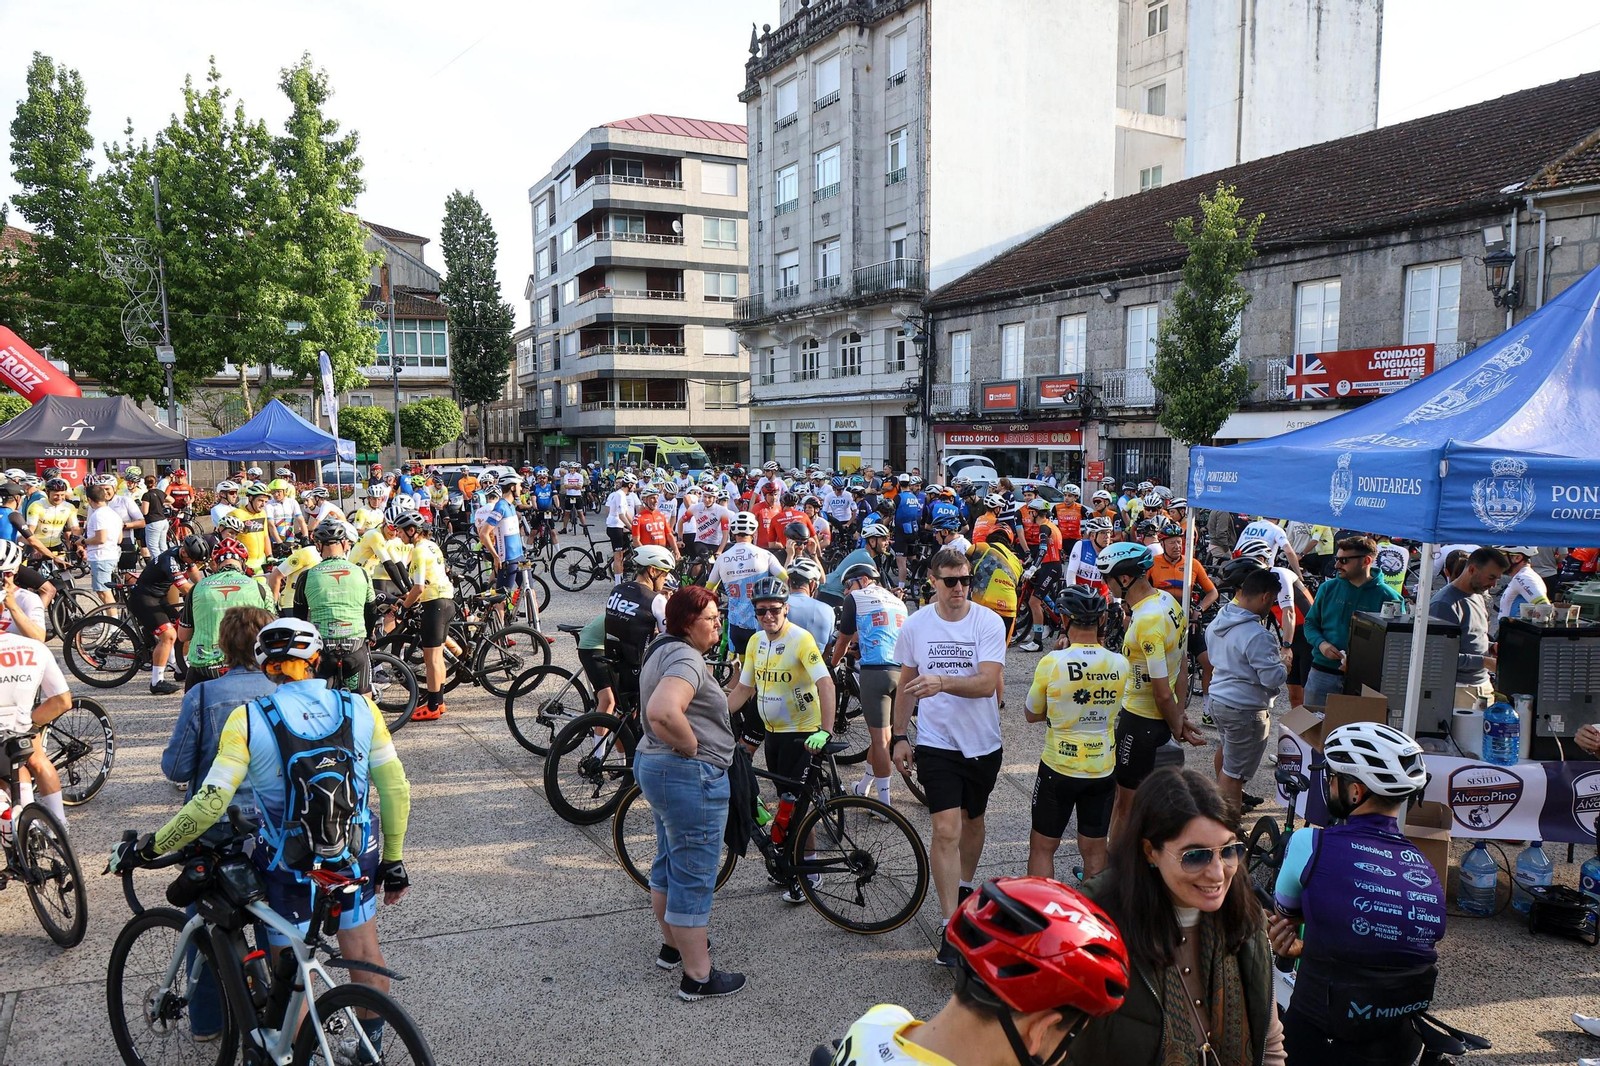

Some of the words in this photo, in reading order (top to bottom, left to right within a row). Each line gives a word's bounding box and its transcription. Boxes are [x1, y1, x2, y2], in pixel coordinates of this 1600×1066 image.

[1374, 348, 1426, 360] CONDADO
[8, 346, 50, 381] supermercados
[1368, 357, 1426, 370] LANGUAGE
[835, 420, 857, 429] ABANCA
[975, 434, 999, 442] ÓPTICO
[1004, 434, 1034, 443] LENTES
[1037, 433, 1048, 442] DE
[1051, 433, 1071, 442] ORO
[44, 448, 89, 456] SESTELO
[1206, 471, 1238, 483] PONTEAREAS
[1357, 476, 1422, 495] PONTEAREAS
[1355, 496, 1386, 509] CONCELLO
[696, 515, 708, 524] CLUB
[698, 517, 718, 532] TRIATLÓN
[646, 522, 665, 532] CTC
[1243, 527, 1267, 538] ADN
[607, 592, 640, 616] diez
[1086, 671, 1119, 681] travel
[1093, 687, 1117, 700] chc
[1122, 734, 1134, 766] SESTELO
[1467, 775, 1501, 785] SESTELO
[1354, 882, 1402, 897] vagalume
[1373, 905, 1402, 915] VALFER
[1043, 901, 1117, 942] MET
[1371, 926, 1402, 936] FERNANDO
[1376, 1000, 1429, 1018] MINGOS
